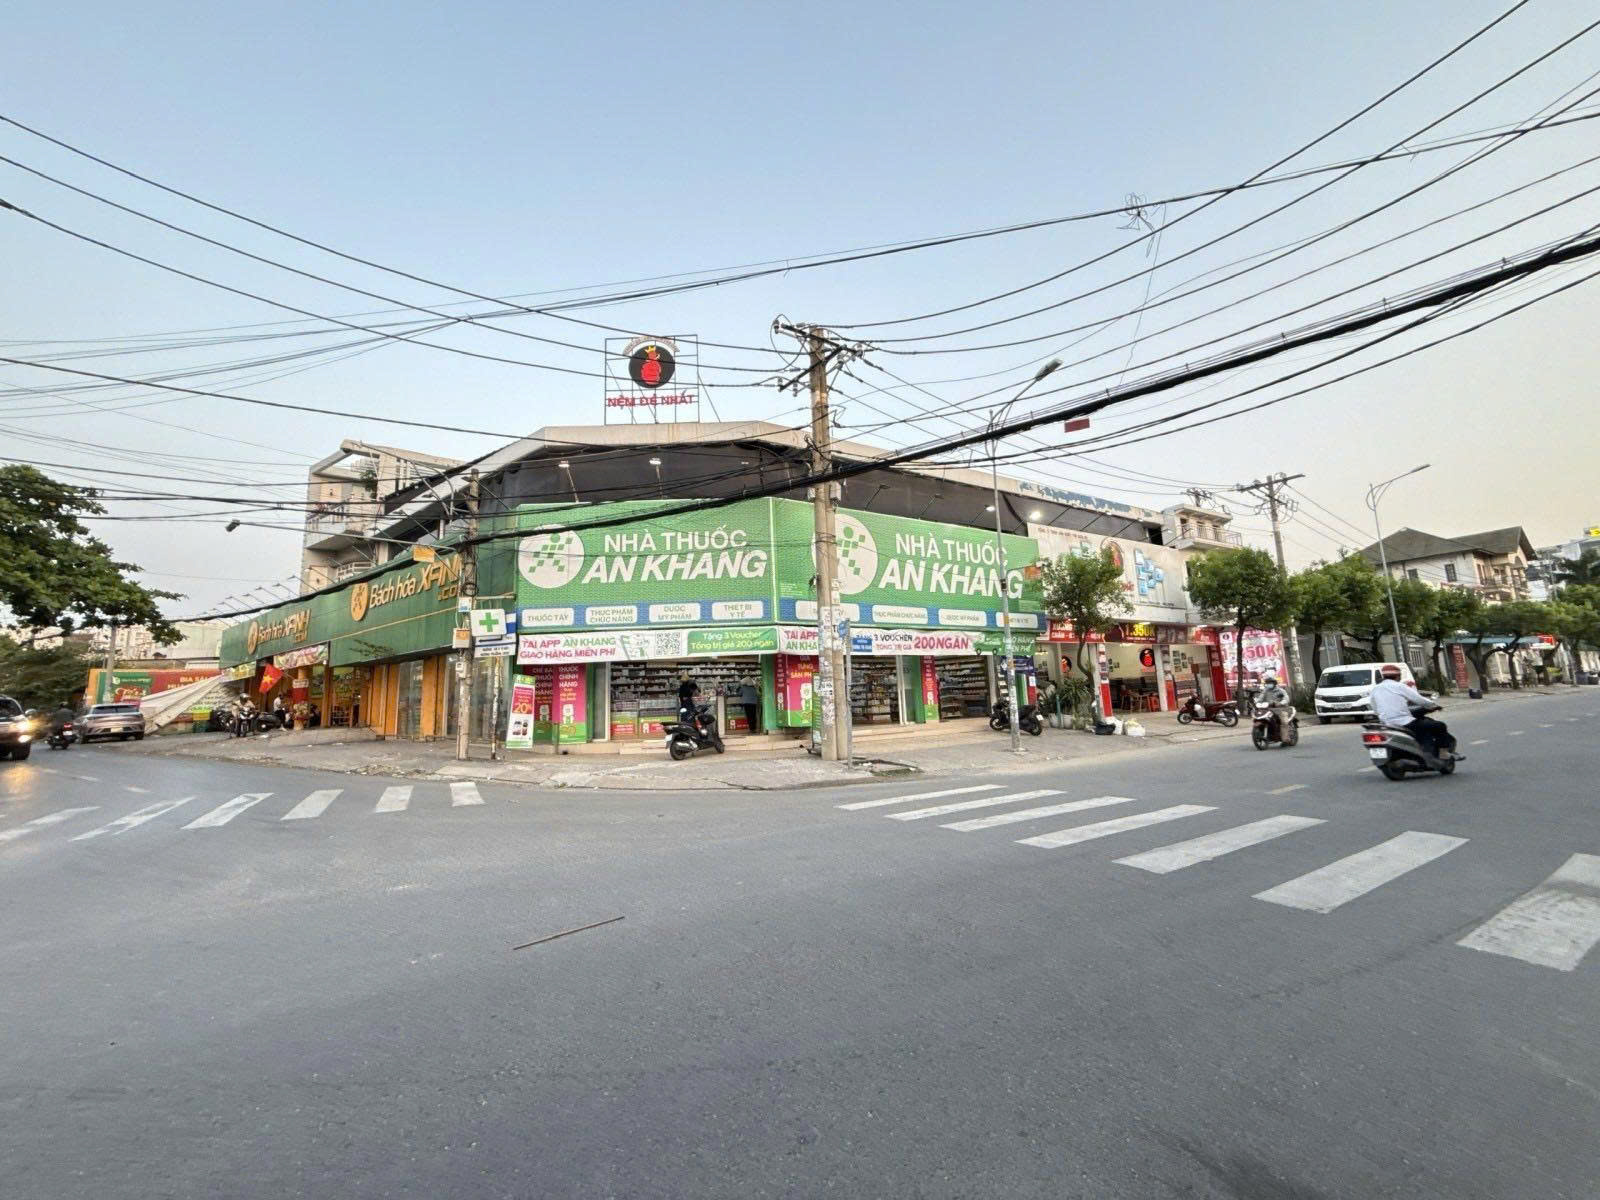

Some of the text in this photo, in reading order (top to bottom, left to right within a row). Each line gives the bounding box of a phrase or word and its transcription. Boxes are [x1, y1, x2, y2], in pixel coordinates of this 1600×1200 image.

[604, 524, 747, 553] NHÀ THUỐC
[895, 532, 1008, 567] NHÀ THUỐC
[581, 550, 767, 583] AN KHANG
[879, 558, 1023, 599] AN KHANG
[369, 578, 394, 608] Bách
[395, 572, 416, 600] hóa
[519, 650, 543, 659] GIAO
[540, 639, 560, 648] APP
[562, 638, 578, 647] AN
[580, 637, 616, 647] KHANG
[786, 641, 818, 650] AN KHA
